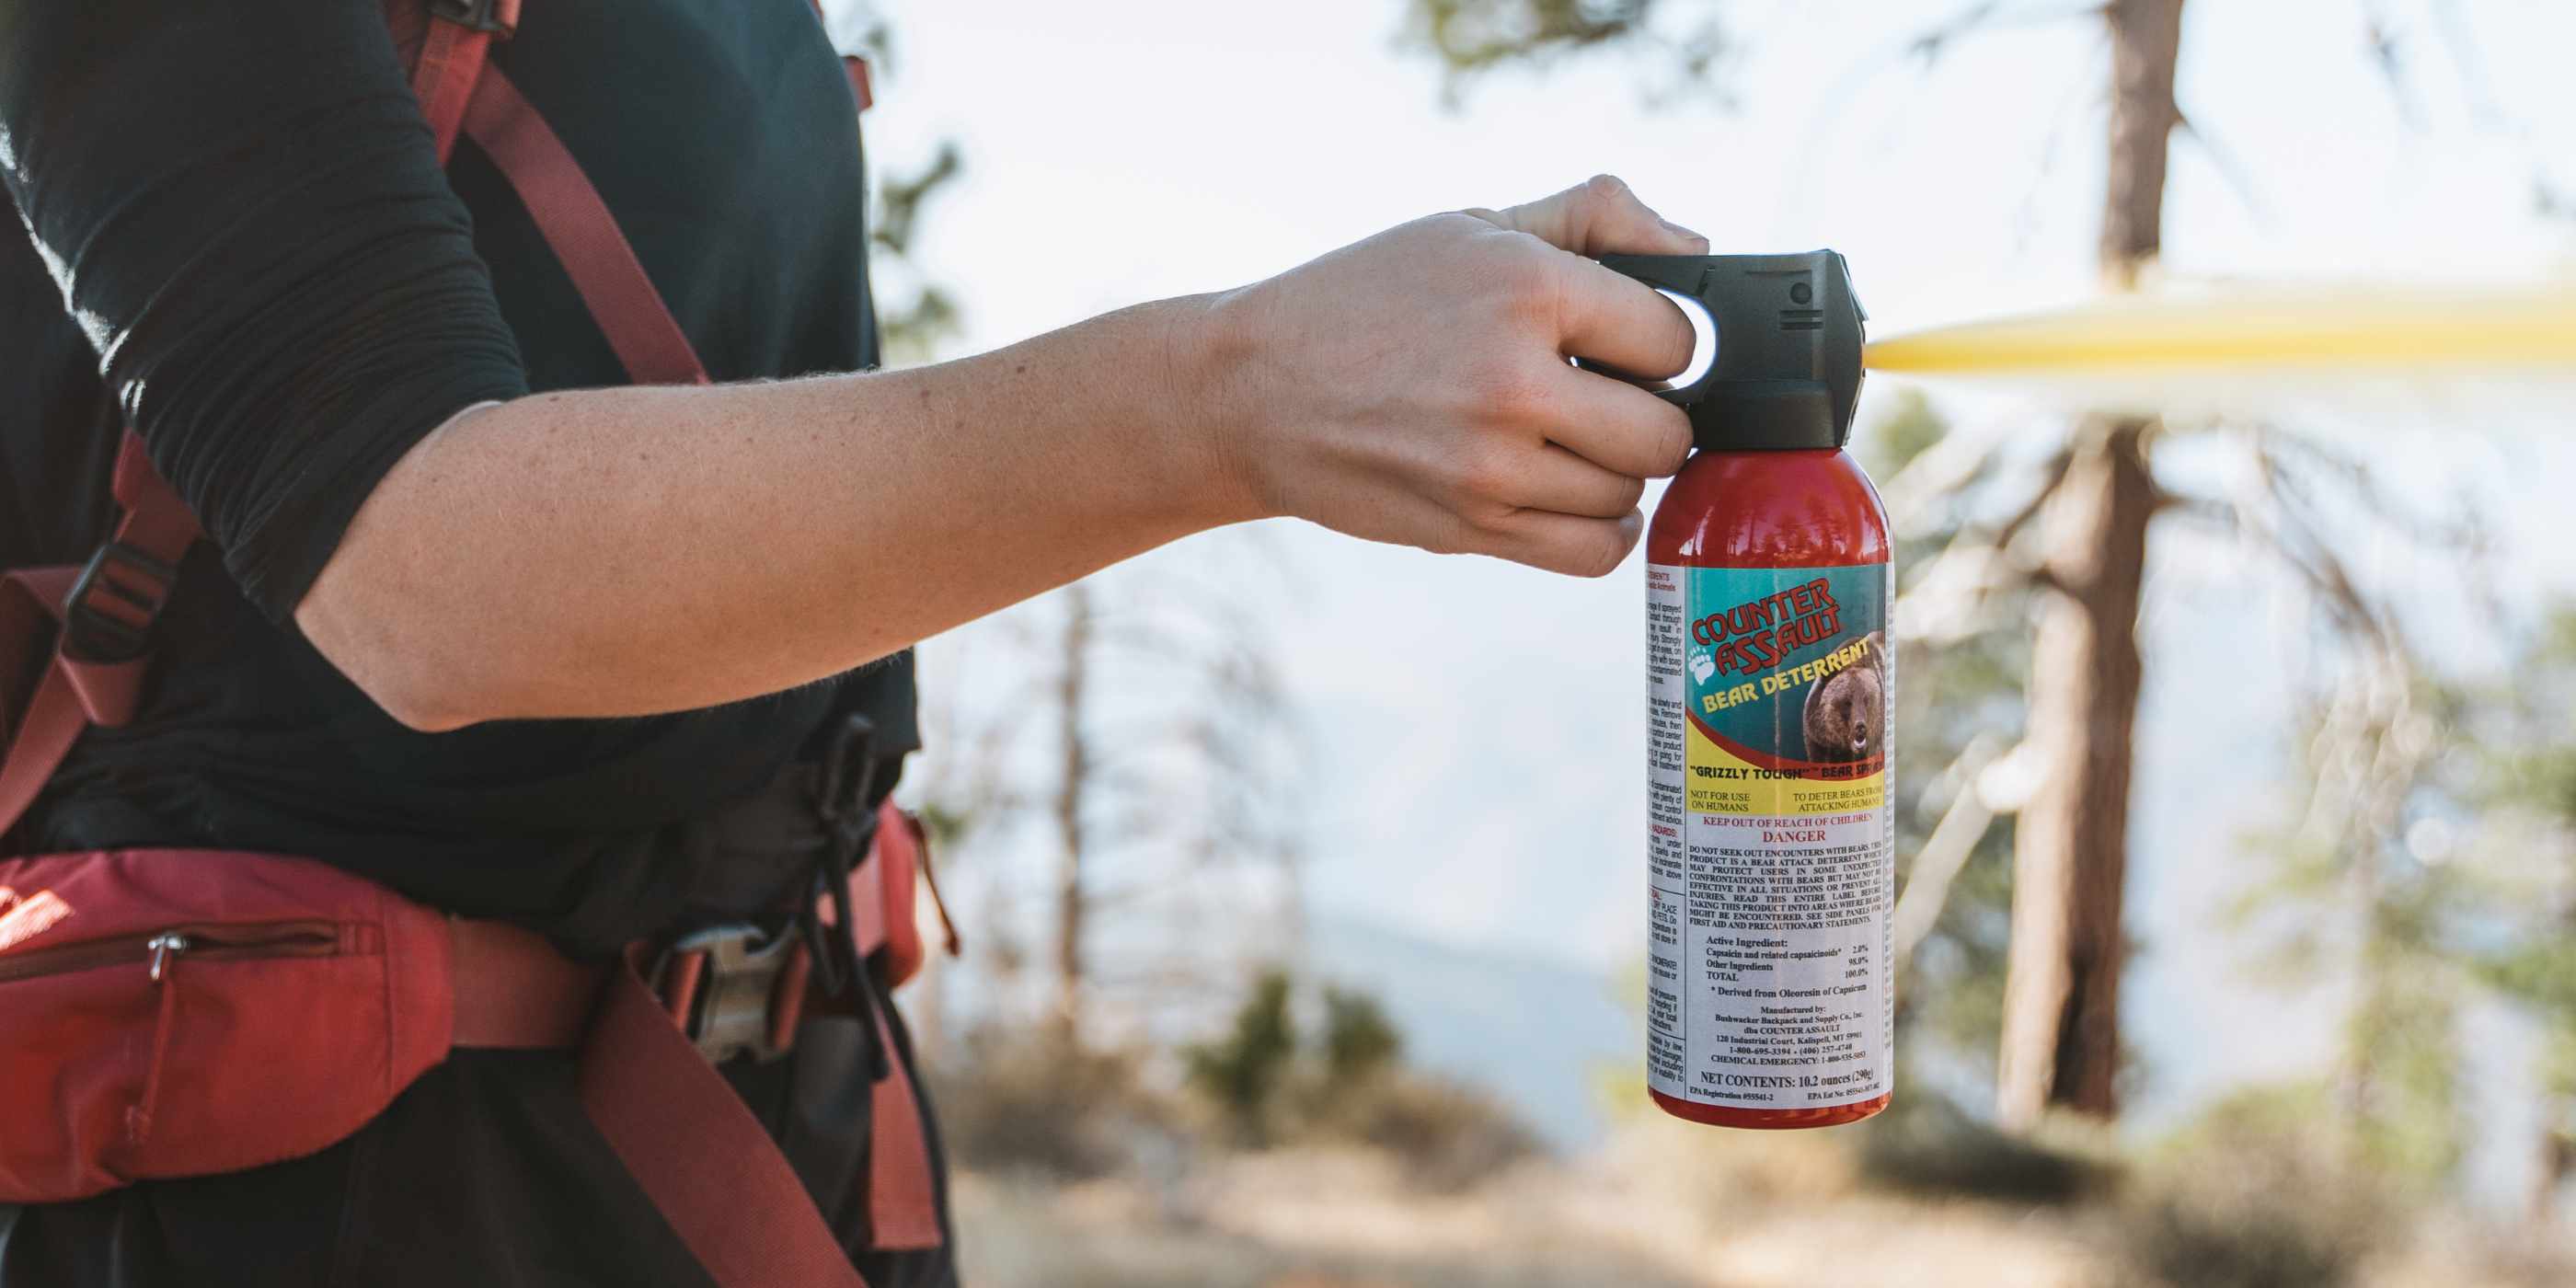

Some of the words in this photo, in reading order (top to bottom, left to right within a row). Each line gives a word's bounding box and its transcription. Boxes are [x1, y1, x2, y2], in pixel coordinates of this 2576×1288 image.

[1692, 578, 1835, 645] COUNTER
[1714, 604, 1841, 677] ASSAULT
[1702, 683, 1758, 714] BEAR
[1761, 638, 1869, 696] DETERRENT
[1689, 765, 1749, 780] "GRIZZLY
[1822, 765, 1853, 777] BEAR
[1690, 789, 1709, 799] NOT
[1710, 791, 1731, 800] FOR
[1731, 792, 1751, 801] USE
[1793, 793, 1807, 801] TO
[1809, 789, 1838, 800] DETER
[1839, 788, 1866, 799] BEARS
[1692, 799, 1705, 809] ON
[1707, 801, 1749, 811] HUMANS
[1798, 799, 1850, 811] ATTACKING
[1703, 817, 1731, 826] KEEP
[1731, 818, 1754, 828] OUT
[1756, 818, 1772, 828] OF
[1774, 817, 1811, 828] REACH
[1814, 817, 1829, 826] OF
[1831, 814, 1874, 826] CHILDREN
[1763, 830, 1826, 844] DANGER
[1689, 845, 1702, 854] DO
[1701, 846, 1719, 855] NOT
[1718, 847, 1742, 857] SEEK
[1744, 849, 1763, 857] OUT
[1765, 847, 1824, 857] ENCOUNTERS
[1826, 846, 1847, 856] WITH
[1689, 855, 1728, 865] PRODUCT
[1751, 858, 1775, 867] BEAR
[1779, 857, 1814, 867] ATTACK
[1817, 854, 1863, 864] DETERRENT
[1689, 864, 1705, 873] MAY
[1712, 866, 1754, 875] PROTECT
[1761, 868, 1788, 876] USERS
[1813, 866, 1837, 874] SOME
[1843, 859, 1881, 873] UNEXPECTED
[1689, 872, 1765, 884] CONFRONTATIONS
[1768, 876, 1793, 884] WITH
[1797, 875, 1824, 883] BEARS
[1827, 874, 1844, 882] BUT
[1846, 871, 1860, 880] MAY
[1861, 869, 1874, 879] NOT
[1689, 882, 1733, 892] EFFECTIVE
[1737, 885, 1746, 893] IN
[1749, 885, 1767, 893] ALL
[1771, 884, 1823, 893] SITUATIONS
[1841, 879, 1871, 890] PREVENT
[1733, 894, 1758, 903] READ
[1765, 894, 1787, 903] THIS
[1794, 892, 1827, 902] ENTIRE
[1832, 890, 1856, 899] LABEL
[1662, 902, 1677, 914] PLACE
[1689, 901, 1719, 911] TAKING
[1720, 903, 1741, 911] THIS
[1742, 903, 1787, 912] PRODUCT
[1811, 901, 1839, 911] AREAS
[1840, 898, 1864, 909] WHERE
[1689, 909, 1715, 919] MIGHT
[1733, 912, 1802, 921] ENCOUNTERED.
[1806, 912, 1823, 920] SEE
[1825, 909, 1844, 918] SIDE
[1846, 905, 1870, 916] PANELS
[1689, 917, 1711, 927] FIRST
[1712, 920, 1728, 928] AID
[1729, 921, 1747, 930] AND
[1748, 919, 1824, 930] PRECAUTIONARY
[1707, 935, 1734, 946] Active
[1735, 937, 1788, 949] Ingredient:
[1707, 948, 1742, 959] Capsaicin
[1744, 950, 1759, 959] and
[1761, 950, 1788, 959] related
[1707, 960, 1728, 970] Other
[1729, 960, 1774, 972] Ingredients
[1848, 957, 1869, 966] 98.0%
[1707, 971, 1739, 982] TOTAL
[1845, 968, 1869, 979] 100.0%
[1718, 986, 1752, 997] Derived
[1754, 988, 1777, 998] from
[1778, 988, 1822, 997] Oleoresin
[1823, 986, 1832, 995] of
[1815, 1006, 1826, 1014] by:
[1715, 1014, 1760, 1024] Bushwacker
[1761, 1016, 1798, 1025] Backpack
[1800, 1016, 1813, 1024] and
[1814, 1015, 1839, 1024] Supply
[1744, 1024, 1759, 1034] dba
[1760, 1026, 1806, 1035] COUNTER
[1806, 1023, 1840, 1034] ASSAULT
[1730, 1035, 1768, 1045] Industrial
[1770, 1036, 1796, 1046] Court,
[1832, 1034, 1845, 1042] MT
[1710, 1054, 1759, 1064] CHEMICAL
[1760, 1056, 1819, 1065] EMERGENCY:
[1701, 1071, 1723, 1087] NET
[1724, 1074, 1796, 1088] CONTENTS:
[1800, 1075, 1818, 1087] 10.2
[1820, 1074, 1850, 1087] ounces
[1689, 1087, 1702, 1096] EPA
[1703, 1088, 1742, 1100] Registration
[1808, 1091, 1822, 1100] EPA
